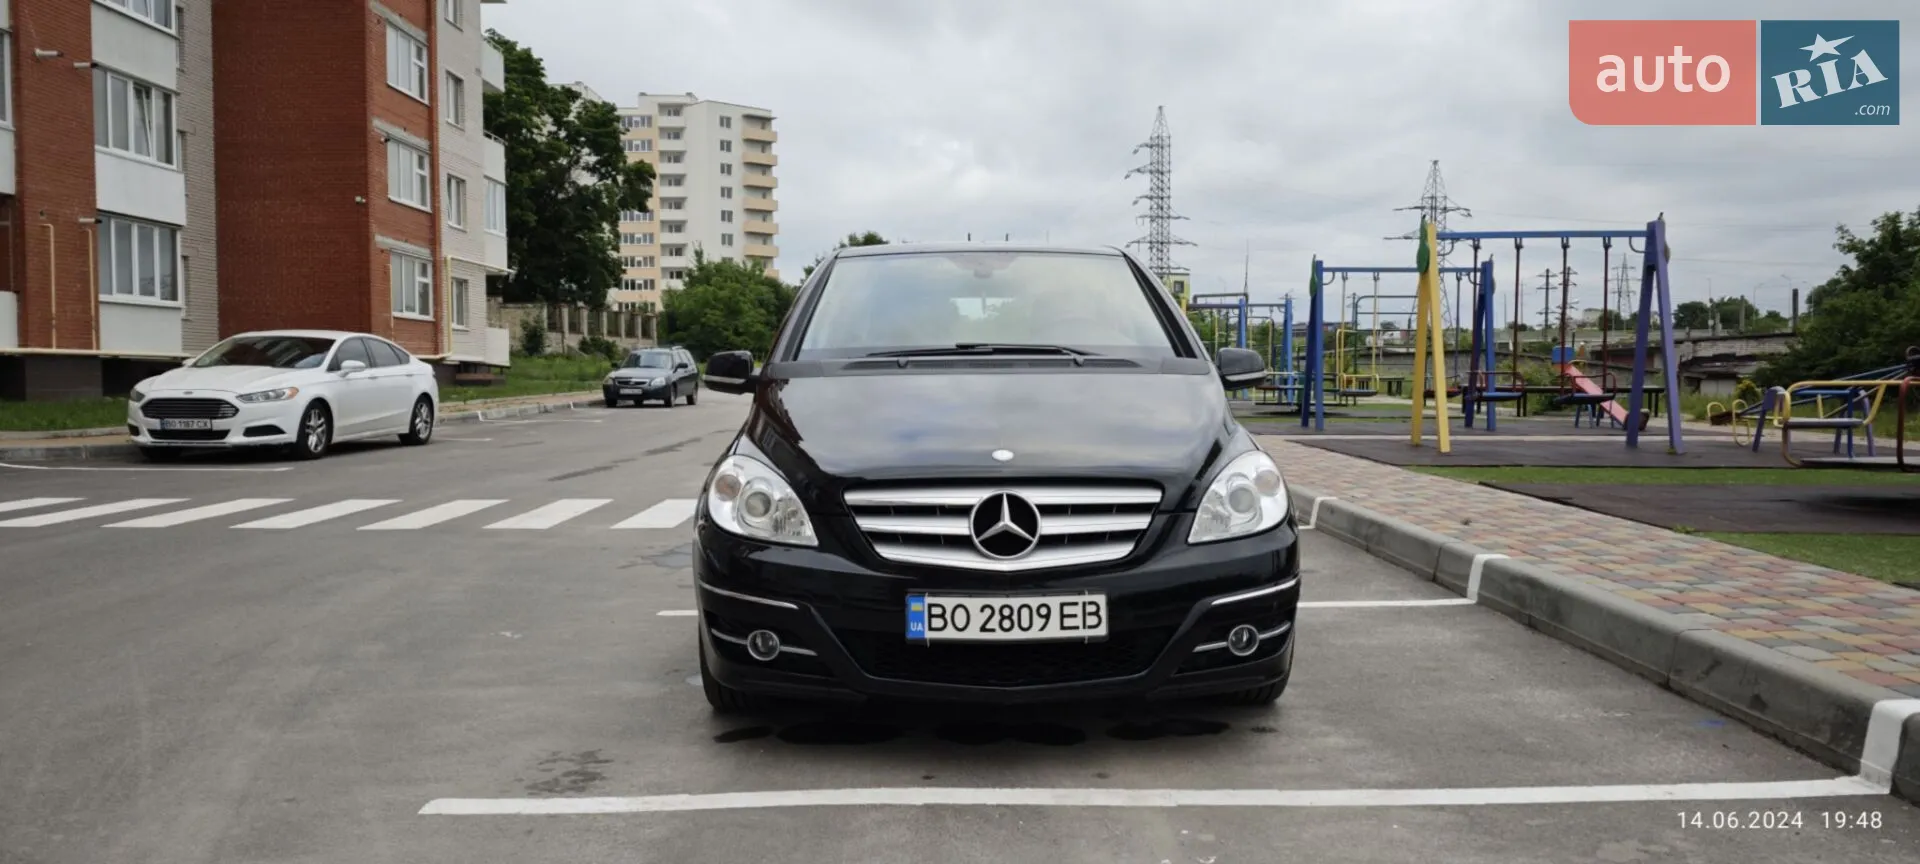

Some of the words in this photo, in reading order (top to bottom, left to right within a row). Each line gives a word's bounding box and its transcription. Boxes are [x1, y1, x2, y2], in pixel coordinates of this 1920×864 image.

[910, 621, 924, 632] UA
[927, 603, 971, 632] BO
[979, 603, 1052, 633] 2809
[1059, 600, 1103, 631] EB
